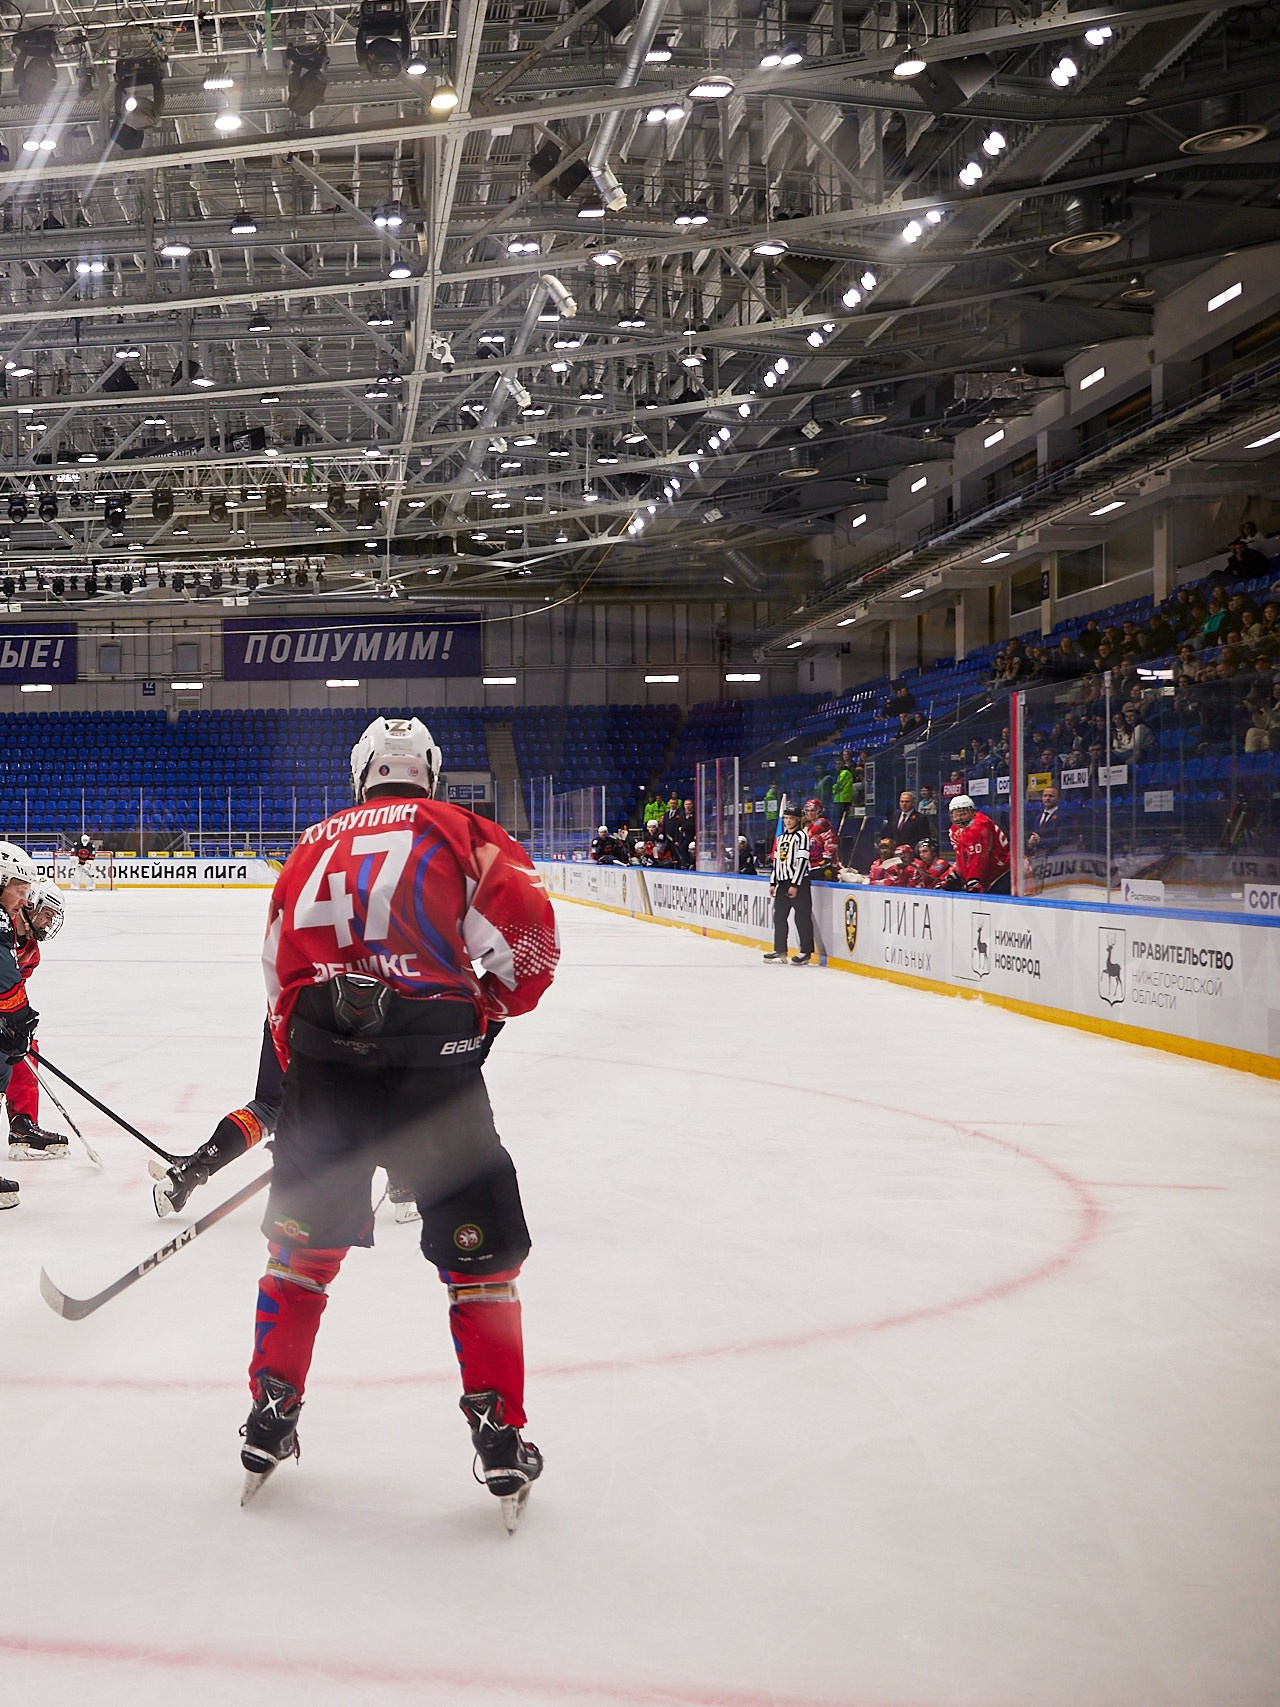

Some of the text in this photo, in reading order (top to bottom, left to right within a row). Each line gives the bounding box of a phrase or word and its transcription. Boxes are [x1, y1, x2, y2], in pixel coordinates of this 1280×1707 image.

[244, 630, 454, 664] ПОШУМИМ!
[1063, 772, 1087, 786] KHL.RU
[300, 803, 419, 845] ХУСНУЛЛИН
[969, 843, 982, 855] 20
[204, 865, 247, 879] ЛИГА
[293, 830, 414, 949] 47
[1131, 891, 1161, 902] Ростелеком
[1249, 890, 1280, 910] СОГ
[699, 883, 749, 925] ХОККЕЙНАЯ
[882, 900, 933, 940] ЛИГА
[994, 929, 1032, 950] НИЖНИЙ
[884, 946, 932, 971] СИЛЬНЫХ
[994, 953, 1041, 980] НОВГОРОД
[1132, 941, 1234, 971] ПРАВИТЕЛЬСТВО
[1132, 968, 1223, 997] НИЖЕГОРОДСКОЙ
[1131, 988, 1177, 1010] ОБЛАСТИ
[137, 1223, 198, 1277] CCM
